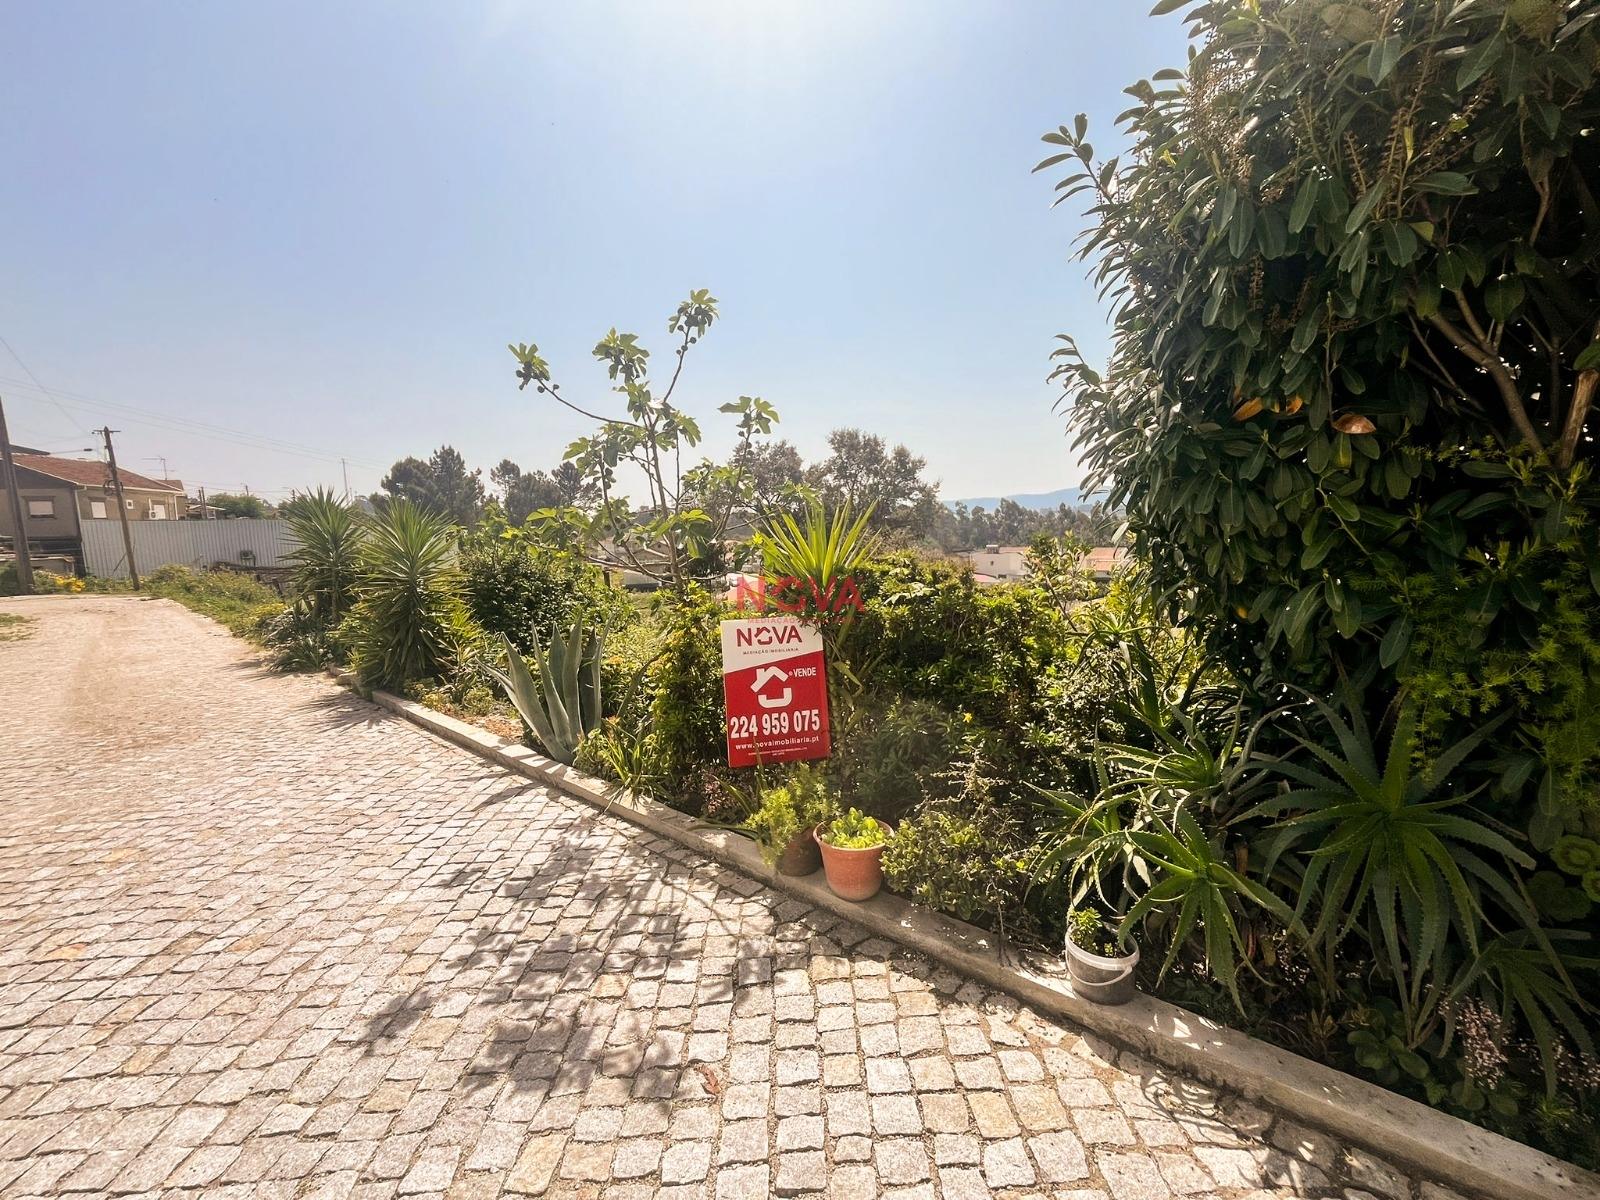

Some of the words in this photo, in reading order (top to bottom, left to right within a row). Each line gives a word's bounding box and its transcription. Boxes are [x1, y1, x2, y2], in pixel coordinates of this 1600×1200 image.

[736, 625, 802, 647] NOVA
[793, 667, 817, 678] VENDE
[730, 715, 758, 739] 224
[762, 712, 789, 736] 959
[793, 709, 820, 733] 075
